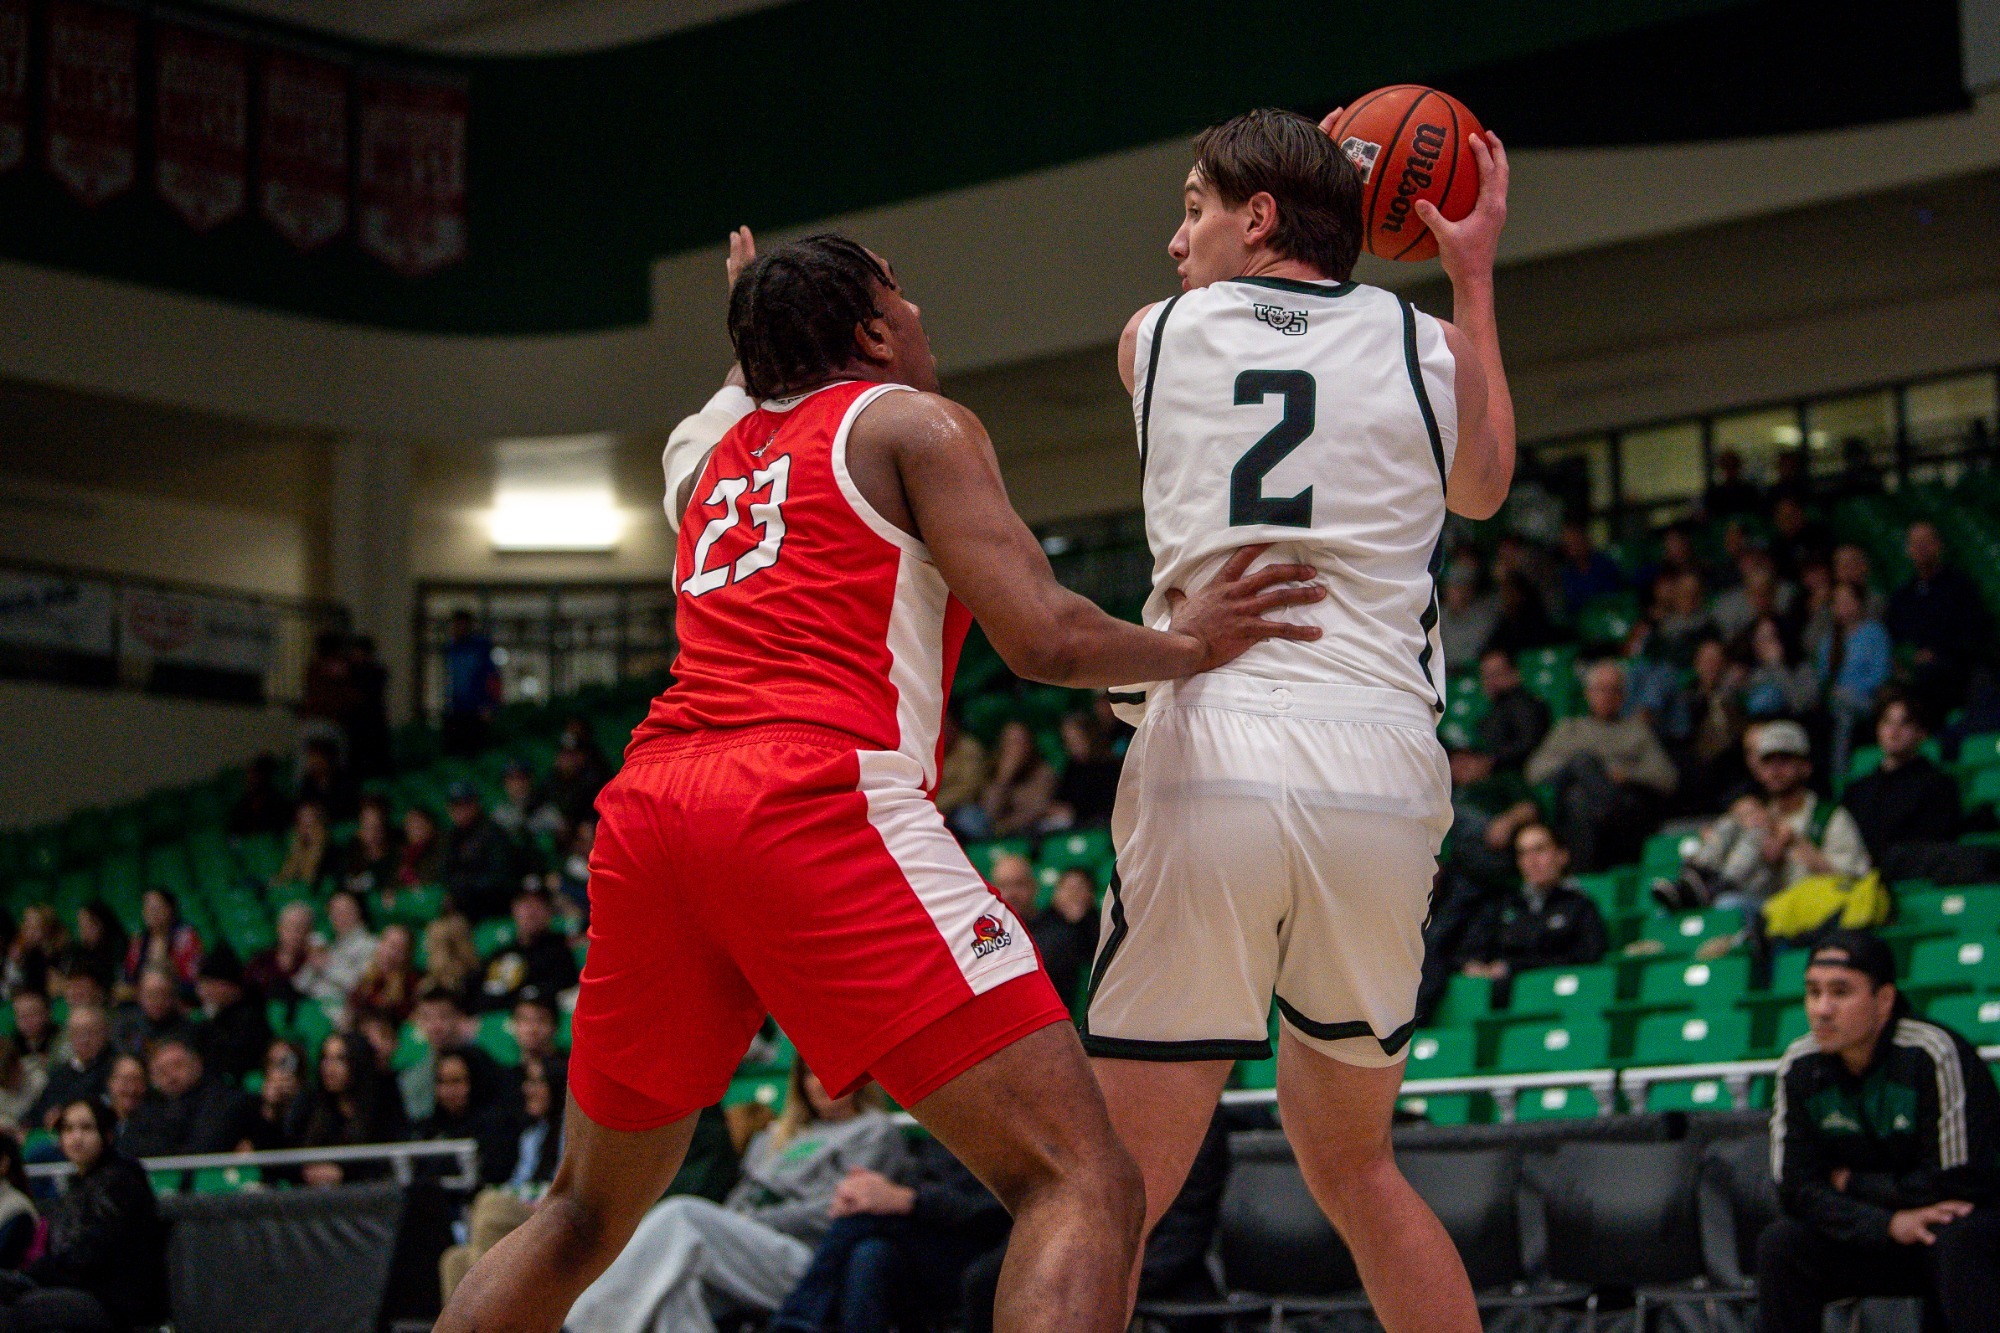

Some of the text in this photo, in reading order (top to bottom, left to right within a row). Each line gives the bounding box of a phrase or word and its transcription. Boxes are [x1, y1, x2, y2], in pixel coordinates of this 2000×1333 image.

[1381, 123, 1447, 232] Wilson
[1230, 369, 1316, 528] 2
[681, 453, 791, 597] 23
[971, 932, 1011, 959] DINOS
